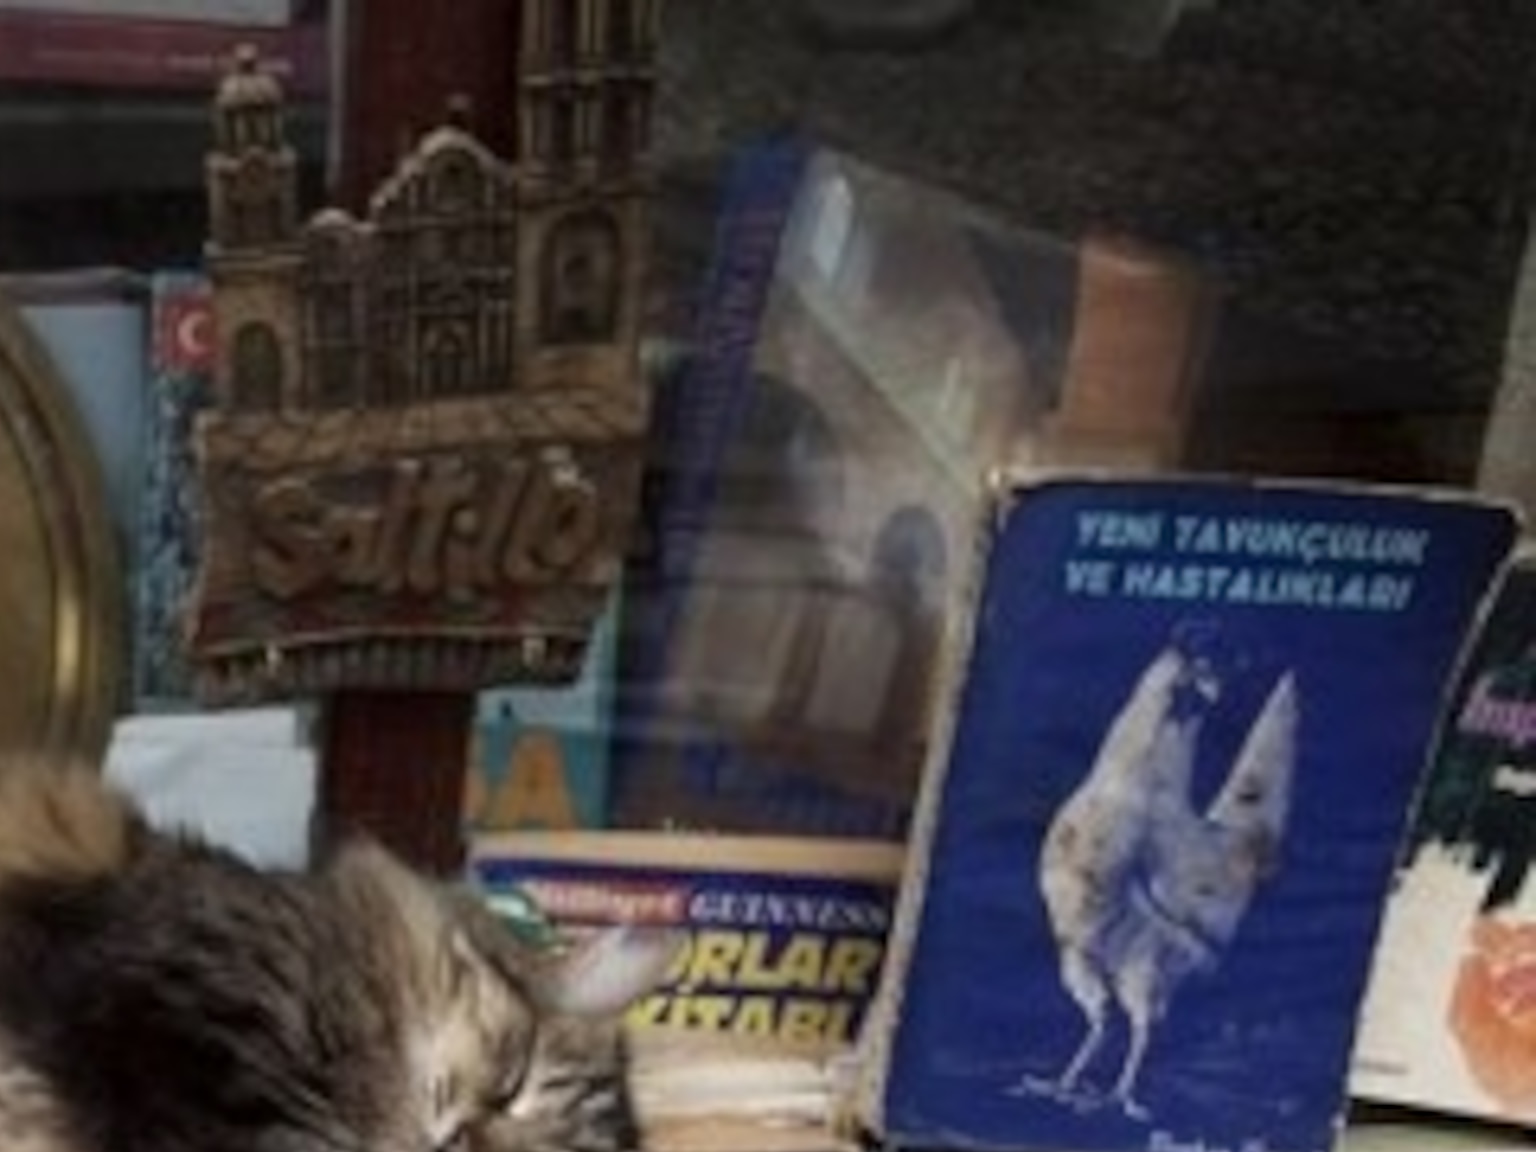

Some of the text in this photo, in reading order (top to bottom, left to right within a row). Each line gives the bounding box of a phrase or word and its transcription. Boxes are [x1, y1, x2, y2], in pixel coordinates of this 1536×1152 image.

[1075, 511, 1162, 550] YENİ
[1065, 561, 1416, 611] VE HASTALIKLARI
